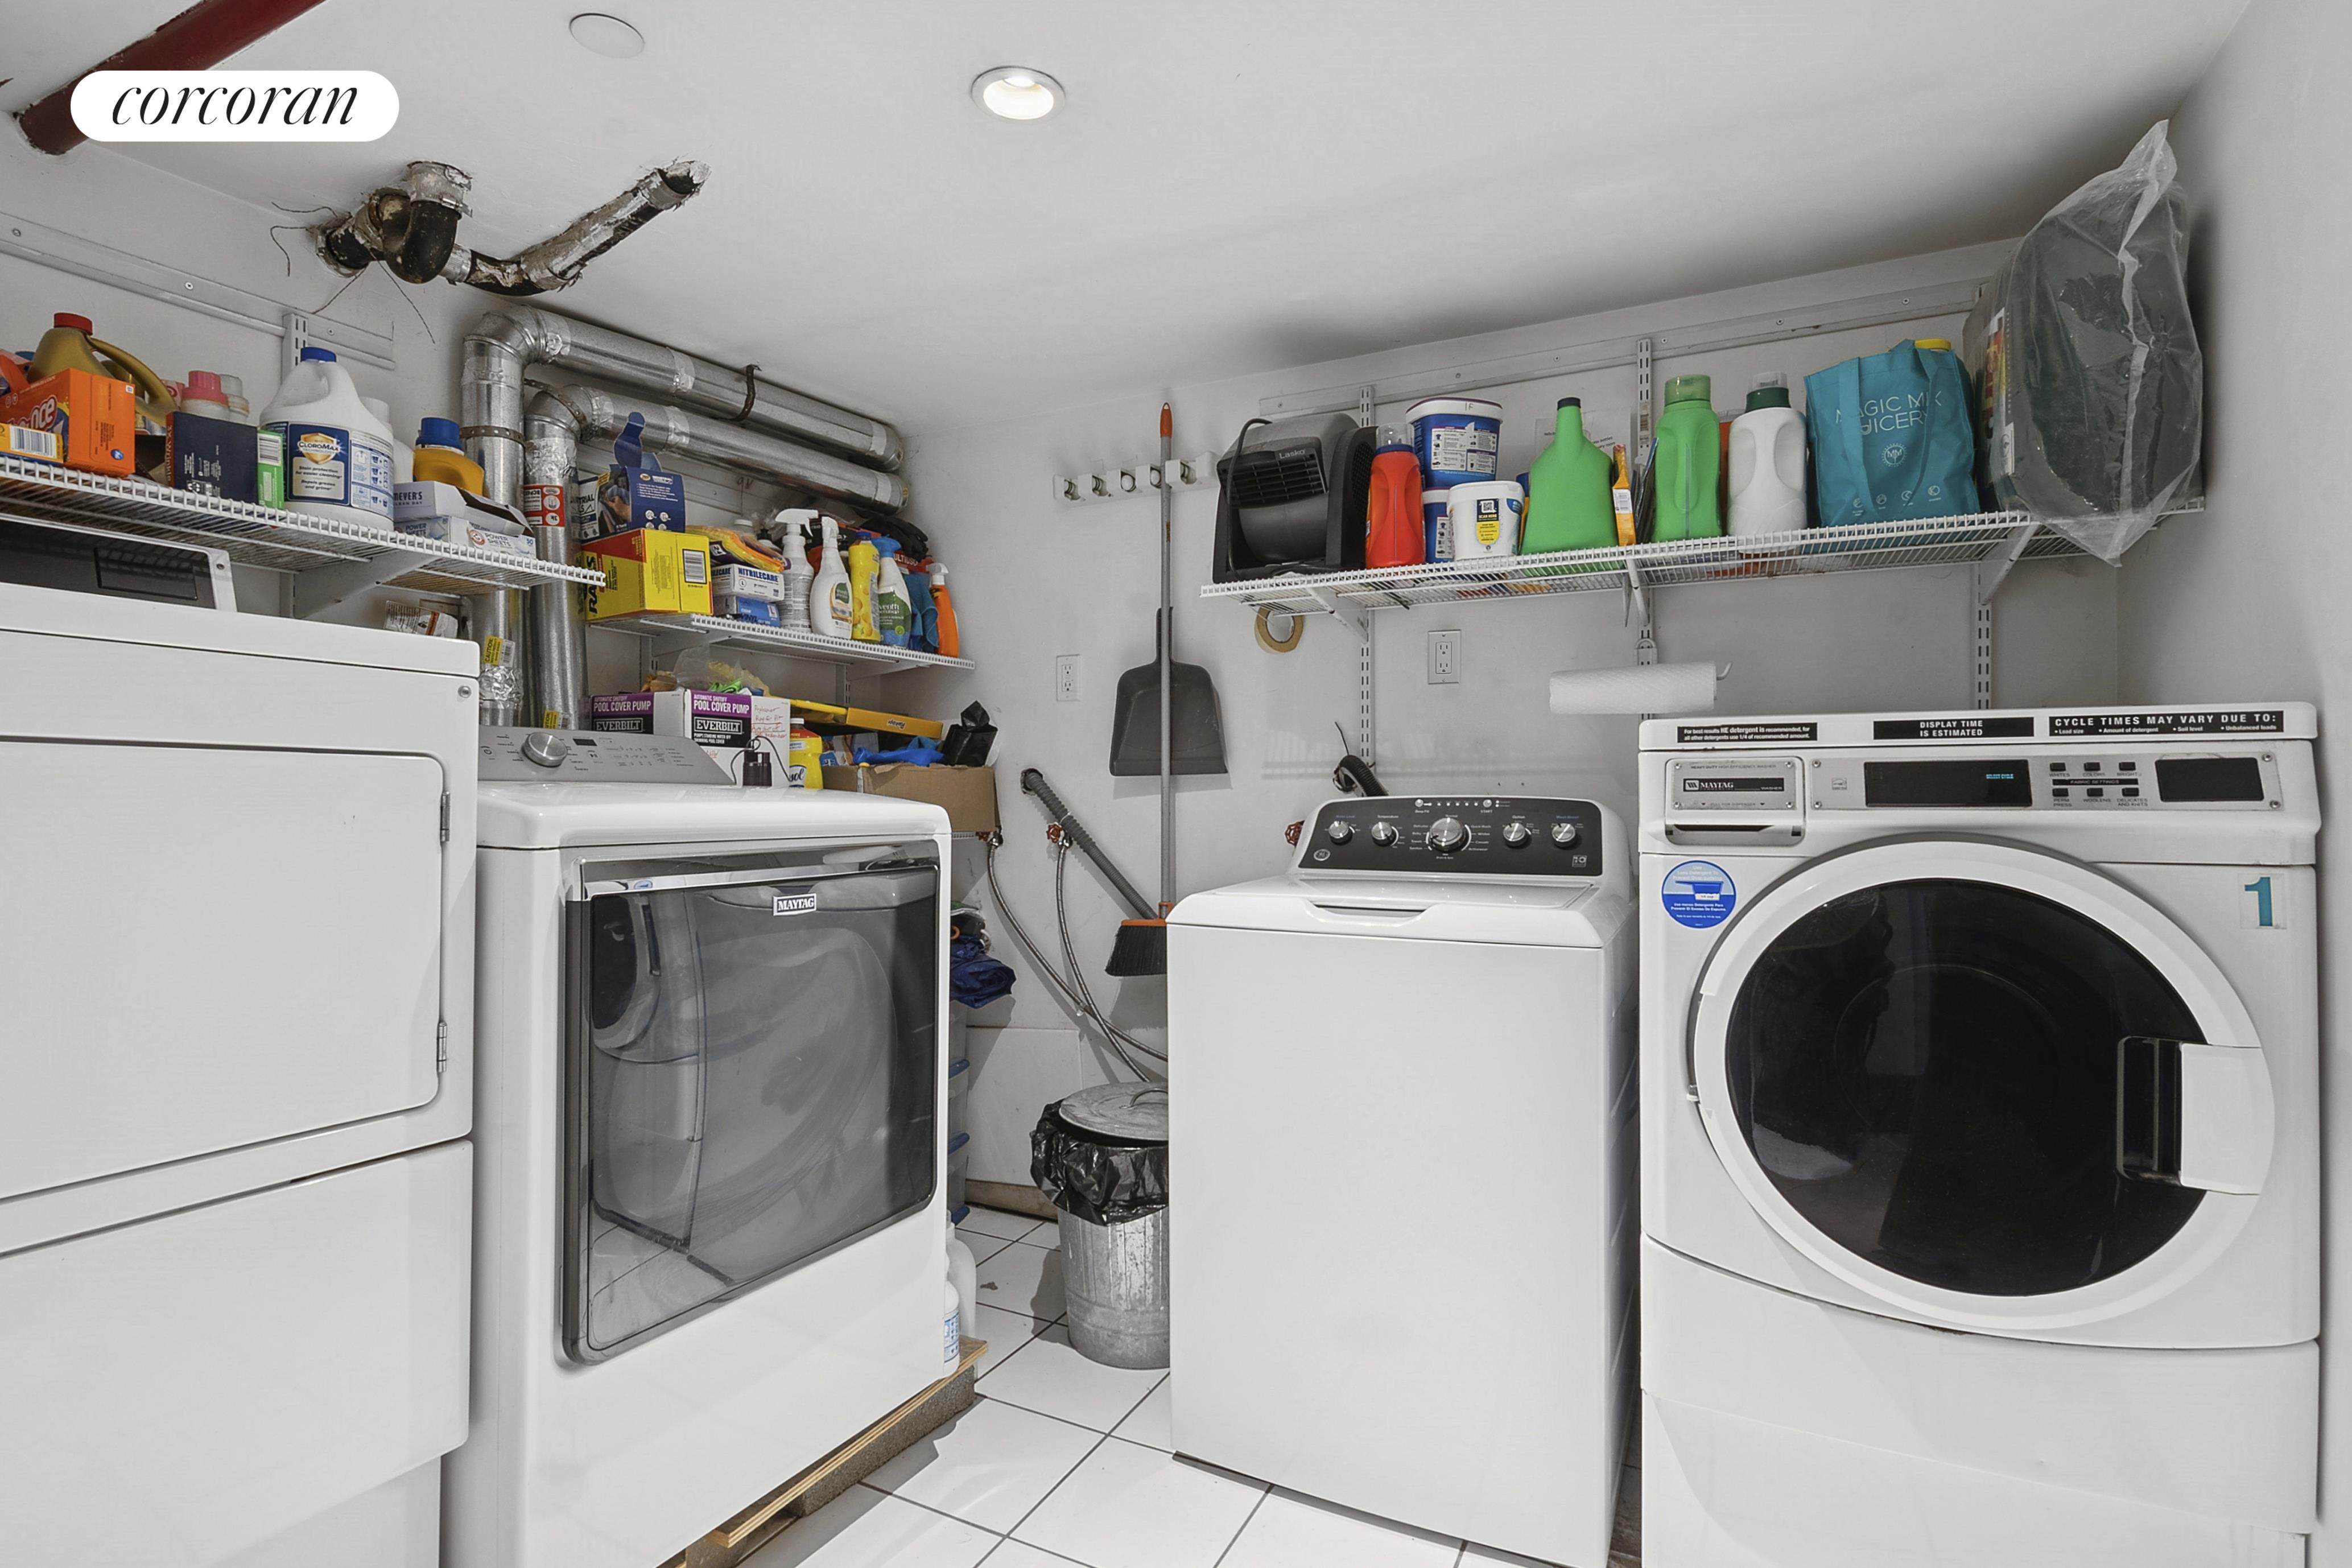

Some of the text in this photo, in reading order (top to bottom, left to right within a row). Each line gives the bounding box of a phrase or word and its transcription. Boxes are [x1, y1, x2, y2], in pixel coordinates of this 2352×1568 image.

[1280, 448, 1306, 459] Lasko
[738, 567, 779, 583] NITRILECARE
[586, 556, 597, 614] RAS
[593, 701, 651, 712] POOL COVER PUMP
[694, 700, 749, 714] POOL COVER PUMP
[596, 720, 640, 731] EVERBILT
[696, 720, 740, 732] EVERBILT
[2055, 713, 2276, 727] CYCLE TIMES MAY VARY DUE TO:
[1730, 727, 1759, 735] detergent
[778, 898, 814, 911] MAYTAG
[2244, 877, 2273, 926] 1
